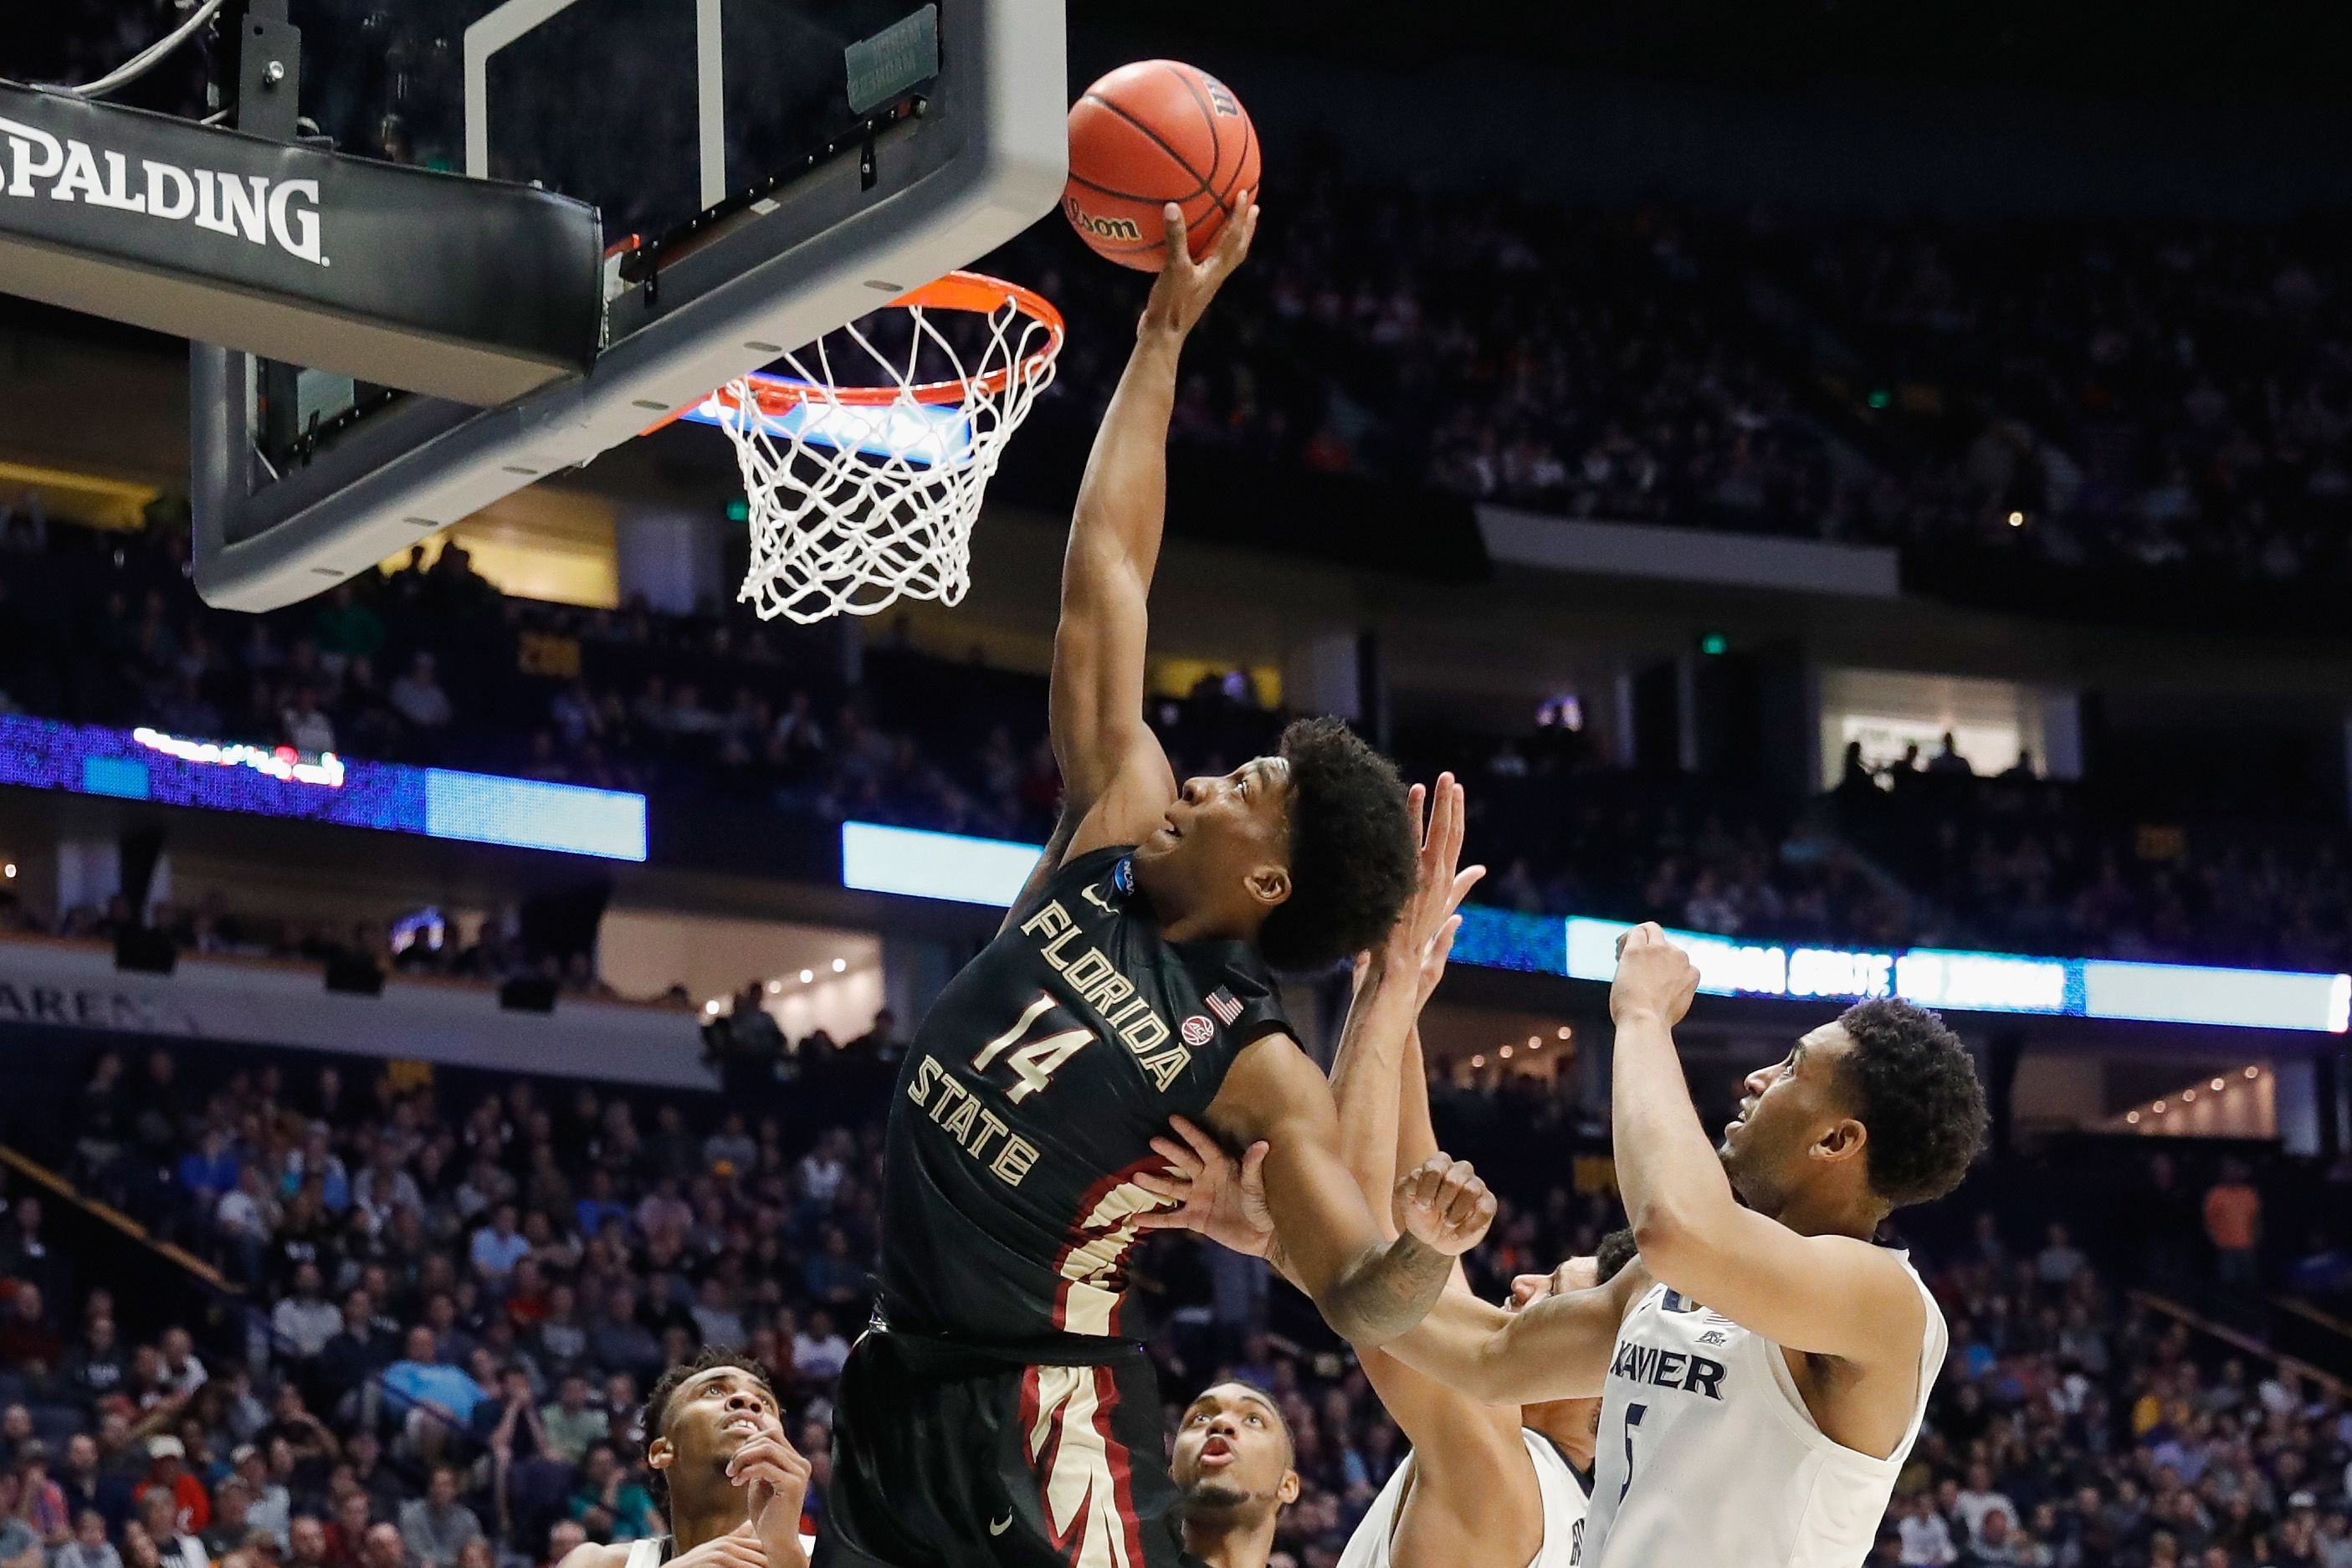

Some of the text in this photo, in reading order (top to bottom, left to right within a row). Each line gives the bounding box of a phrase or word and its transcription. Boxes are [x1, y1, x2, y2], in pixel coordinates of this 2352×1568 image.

[0, 116, 323, 266] PALDING
[971, 989, 1098, 1104] 14
[1020, 899, 1192, 1094] FLORIDA
[1186, 1022, 1212, 1041] ACC
[907, 1054, 1041, 1186] STATE
[1610, 1340, 1727, 1401] XAVIER
